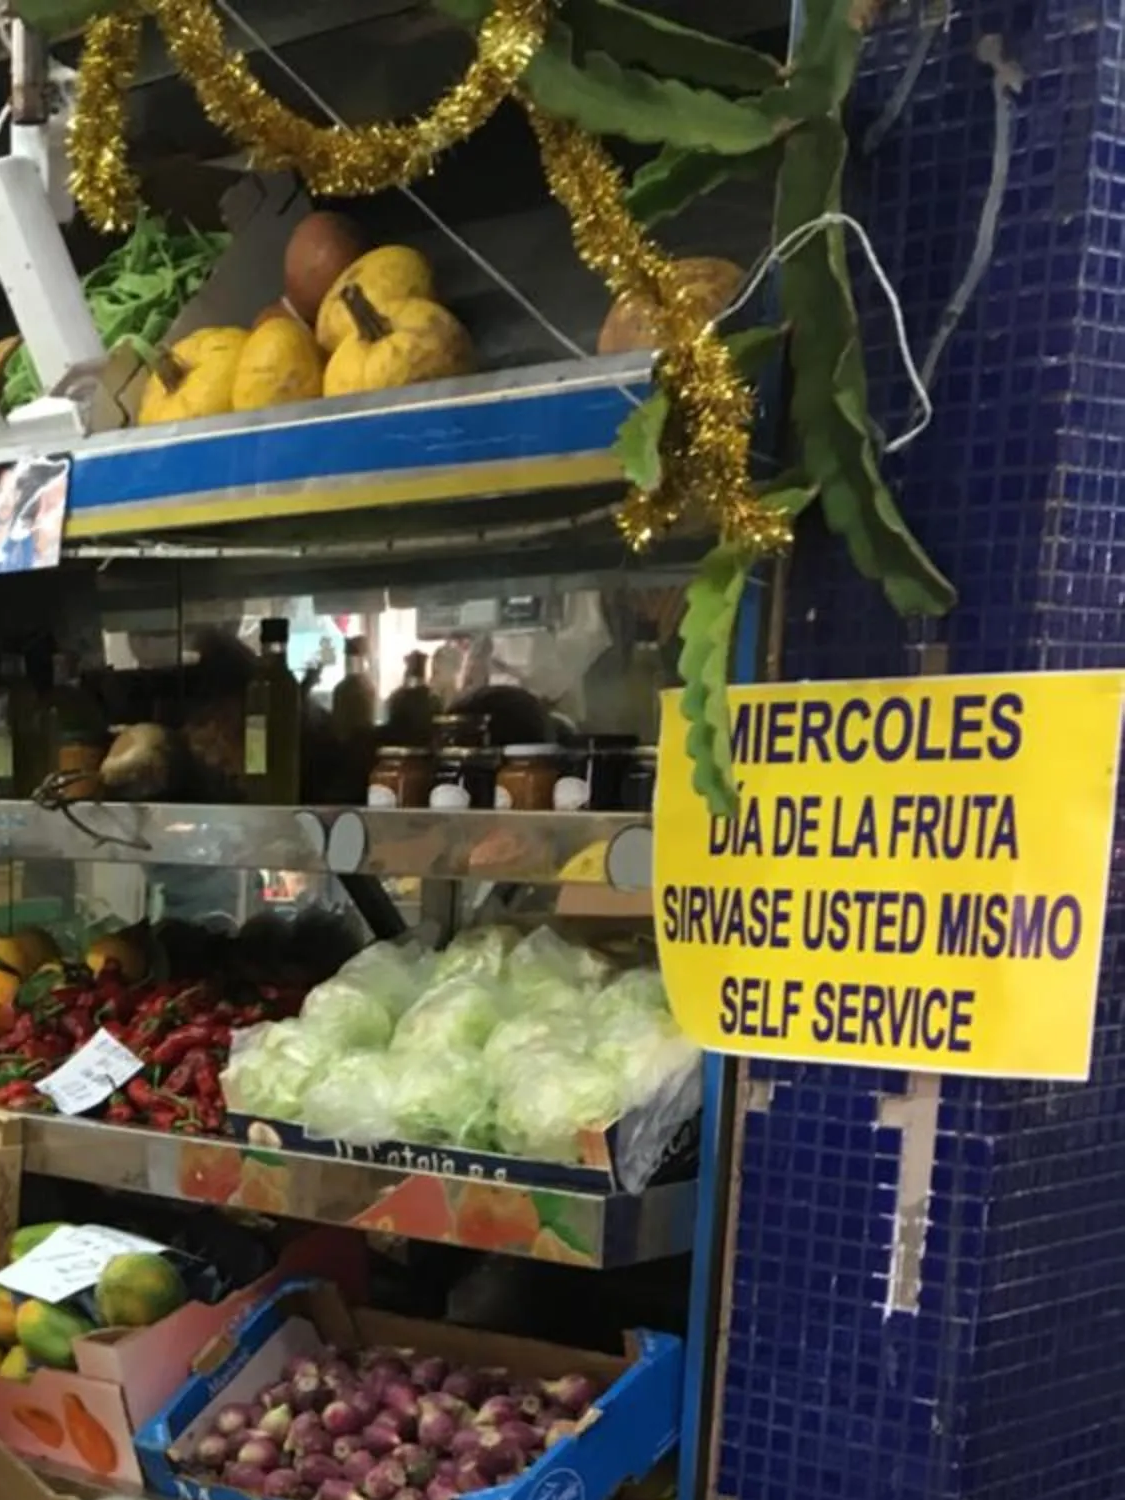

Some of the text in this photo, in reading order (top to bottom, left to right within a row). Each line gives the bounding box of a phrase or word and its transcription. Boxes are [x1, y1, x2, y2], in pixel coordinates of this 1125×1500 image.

[727, 693, 1024, 765] MIERCOLES
[772, 795, 822, 857] DE
[830, 796, 878, 858] LA
[888, 795, 1019, 860] FRUTA
[662, 885, 1083, 961] SIRVASE USTED MISMO
[719, 975, 976, 1053] SELF SERVICE
